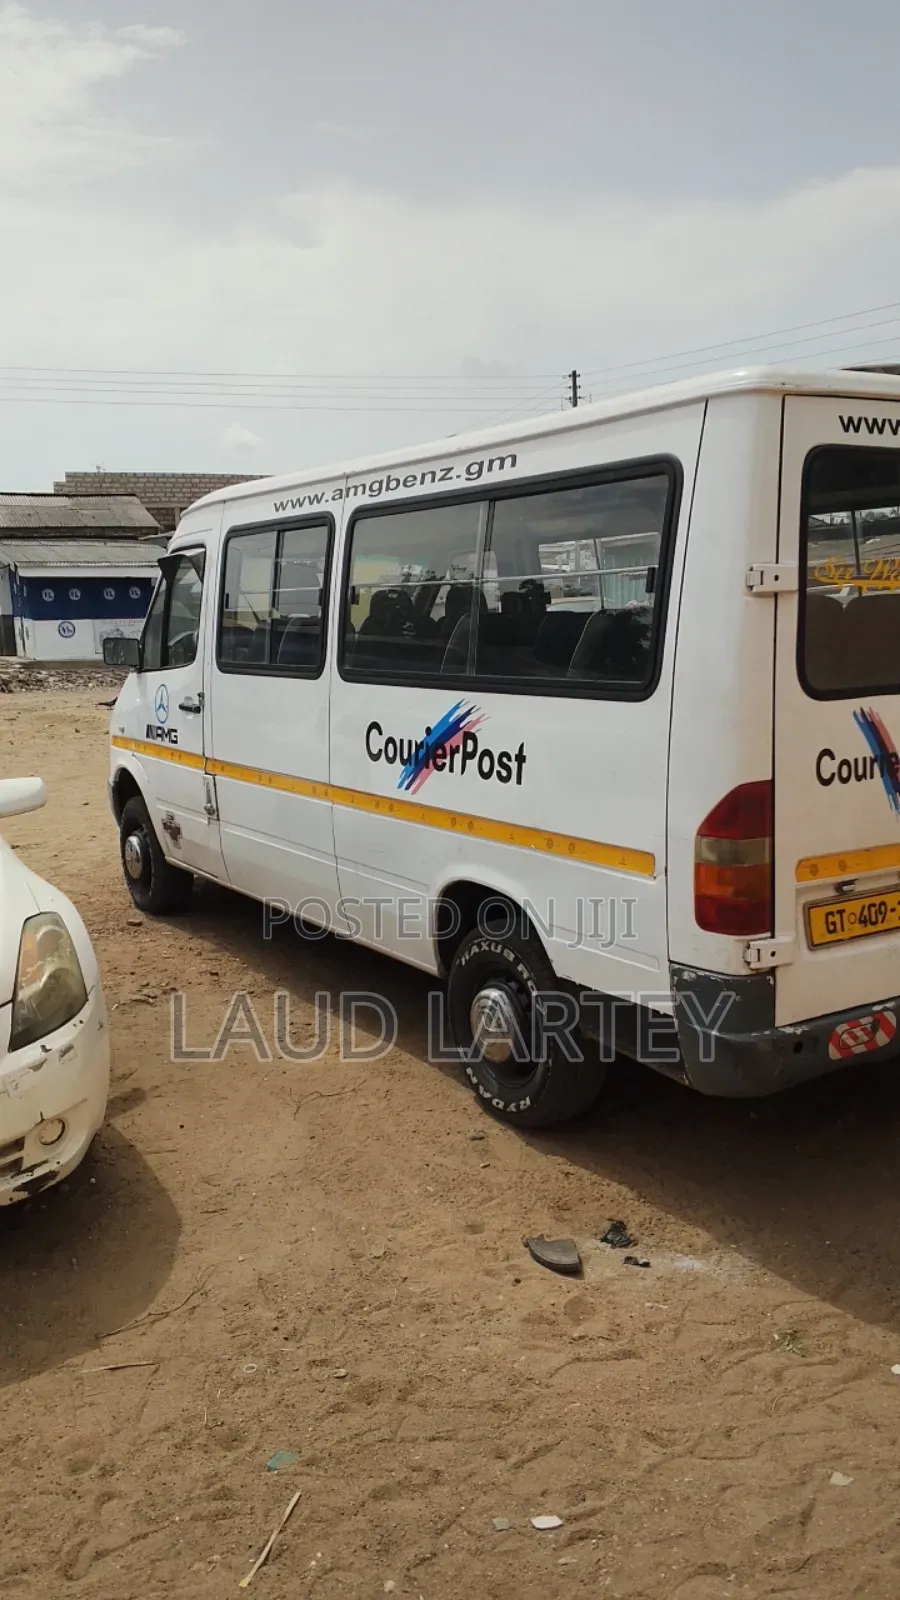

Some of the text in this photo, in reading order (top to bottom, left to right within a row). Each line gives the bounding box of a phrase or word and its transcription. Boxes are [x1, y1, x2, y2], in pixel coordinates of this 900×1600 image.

[273, 453, 517, 513] www.amgbenz.gm
[365, 710, 527, 785] CourierPost
[825, 900, 900, 934] GT 409-
